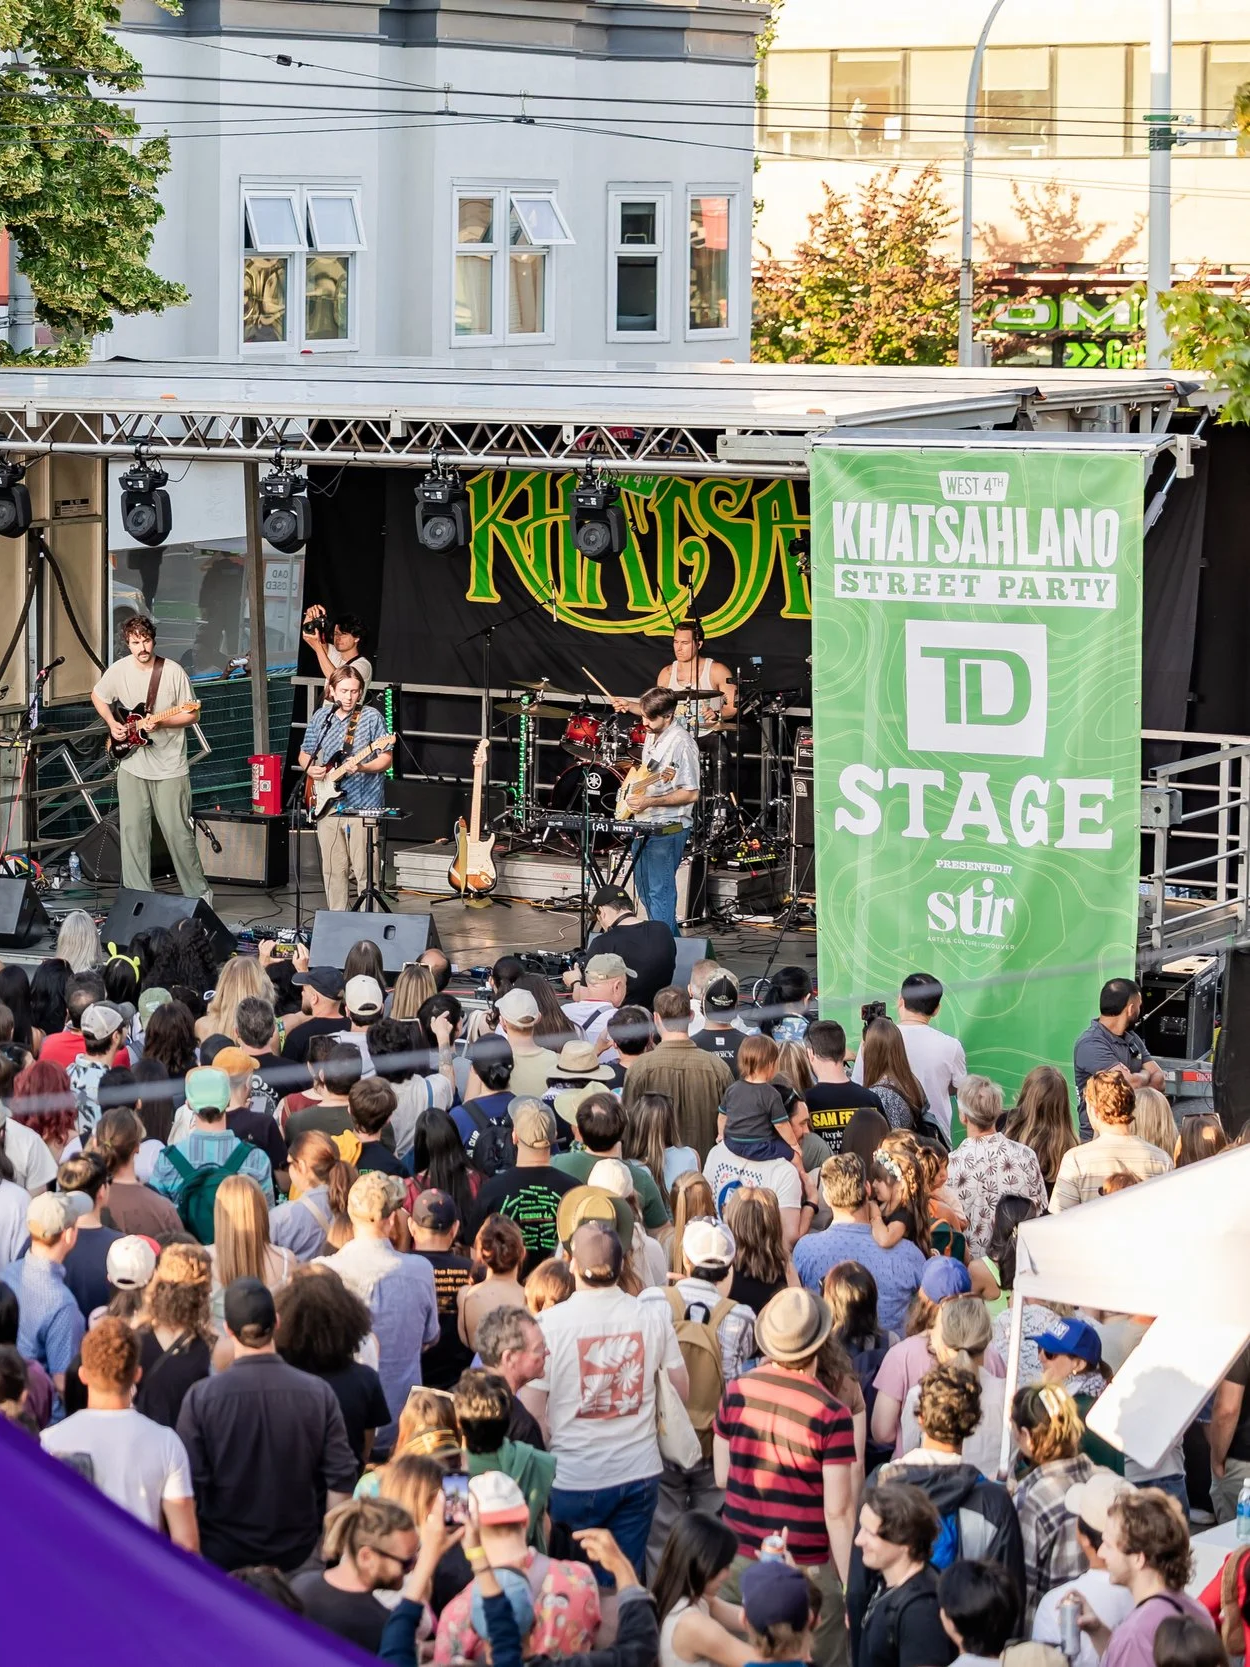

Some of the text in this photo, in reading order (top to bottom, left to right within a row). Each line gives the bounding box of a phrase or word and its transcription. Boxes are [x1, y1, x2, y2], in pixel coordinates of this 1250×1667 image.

[946, 476, 1004, 496] WEST 4TH
[833, 501, 1119, 568] KHATSAHLANO
[841, 570, 1110, 602] STREET PARTY
[920, 647, 1031, 726] TD
[835, 764, 1113, 850] STAGE
[936, 860, 1004, 872] PRESENTED
[927, 879, 1014, 937] stir
[812, 1112, 837, 1127] SAM
